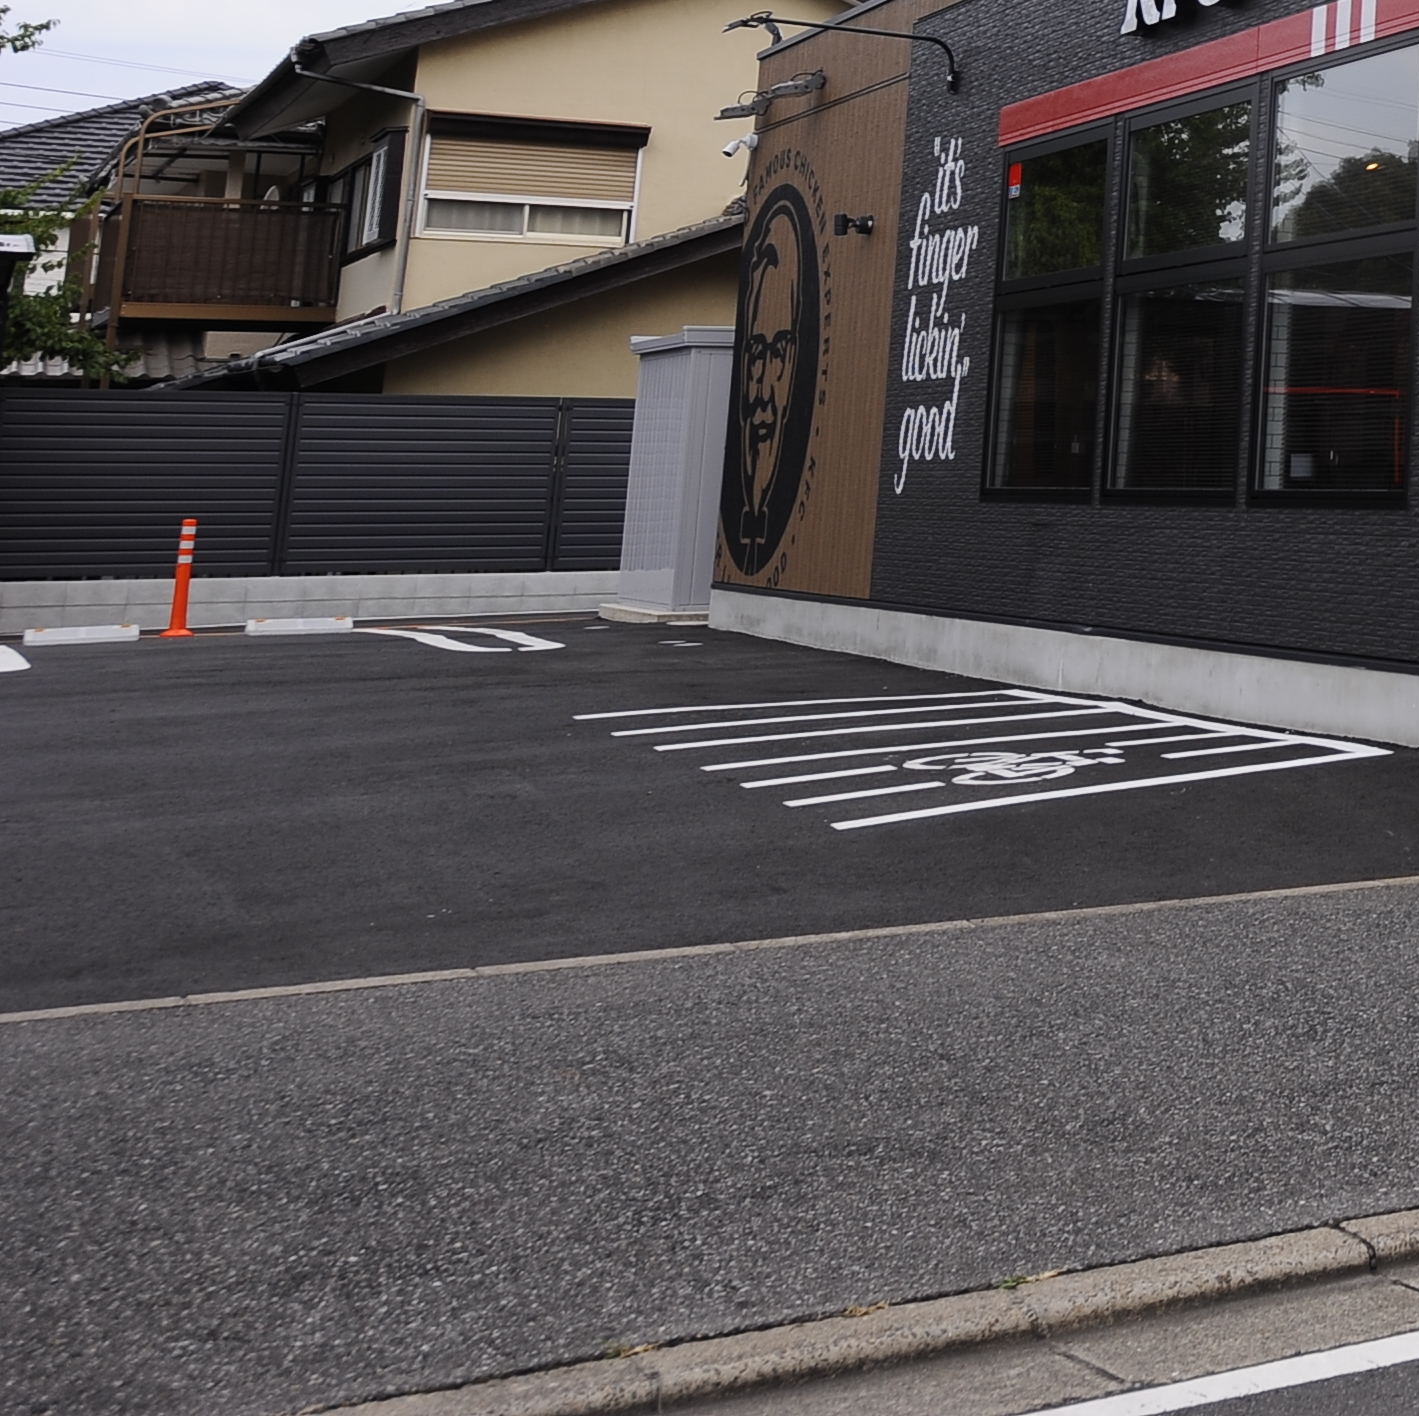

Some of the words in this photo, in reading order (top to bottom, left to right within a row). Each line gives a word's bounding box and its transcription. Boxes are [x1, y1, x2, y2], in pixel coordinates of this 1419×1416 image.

[752, 148, 792, 204] FAMOUS
[794, 150, 827, 234] CHICKEN
[818, 241, 832, 405] EXPERTS
[908, 192, 979, 318] finger
